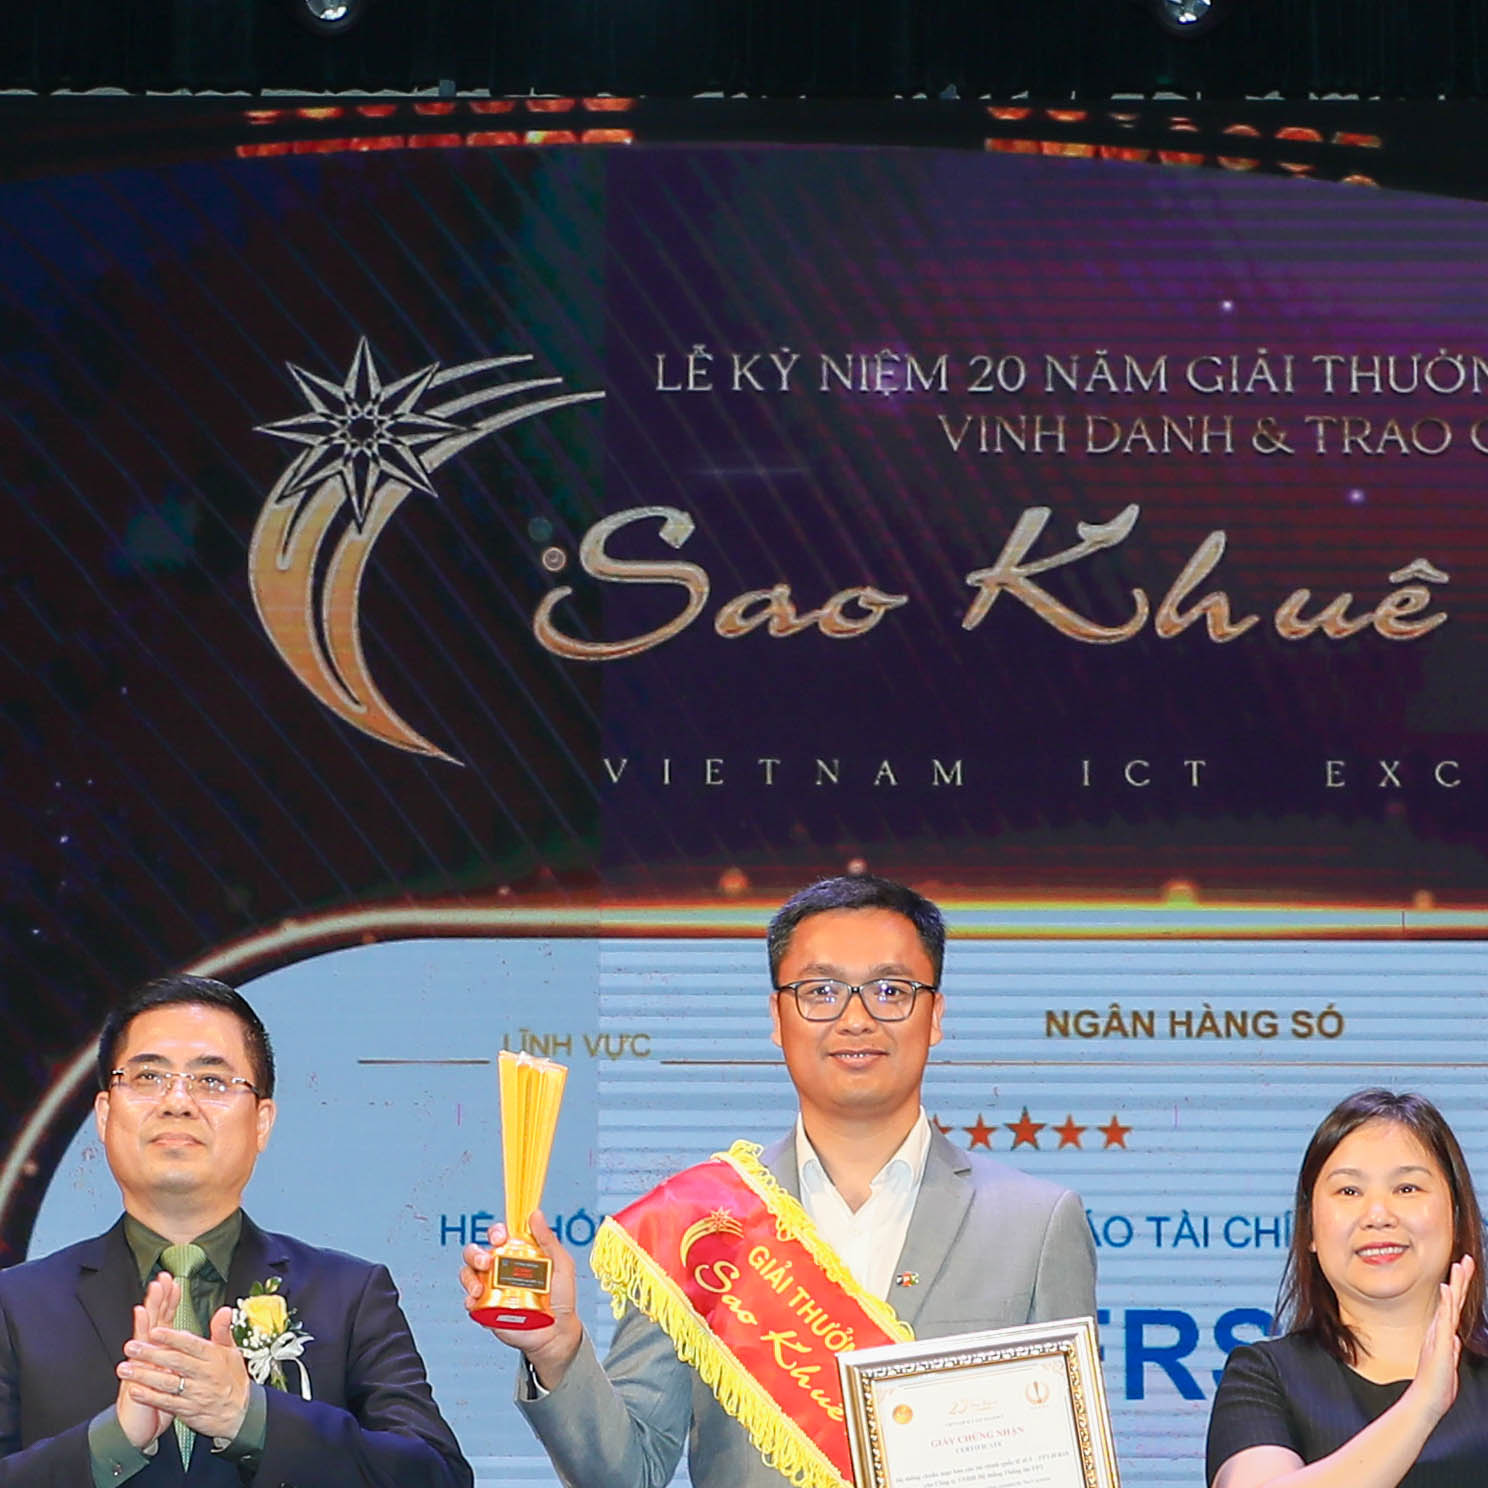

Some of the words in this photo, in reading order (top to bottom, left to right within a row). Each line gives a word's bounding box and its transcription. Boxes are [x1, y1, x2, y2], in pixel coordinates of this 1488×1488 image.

[819, 349, 949, 396] NIỆM
[968, 355, 1026, 392] 20
[1044, 349, 1168, 392] NĂM
[937, 414, 1066, 454] VINH
[1085, 414, 1234, 455] DANH
[1251, 414, 1295, 455] &
[1304, 415, 1453, 456] TRAO
[533, 504, 908, 661] Sao
[961, 503, 1450, 643] Khuê
[602, 756, 965, 786] VIETNAM
[1081, 758, 1208, 788] ICT
[1045, 1002, 1155, 1038] NGÂN
[1169, 1002, 1279, 1038] HÀNG
[1145, 1208, 1209, 1248] TÀI
[1223, 1209, 1293, 1248] CHÍ
[748, 1245, 795, 1295] GIẢI
[693, 1260, 759, 1326] Sao
[760, 1329, 845, 1422] Khuê
